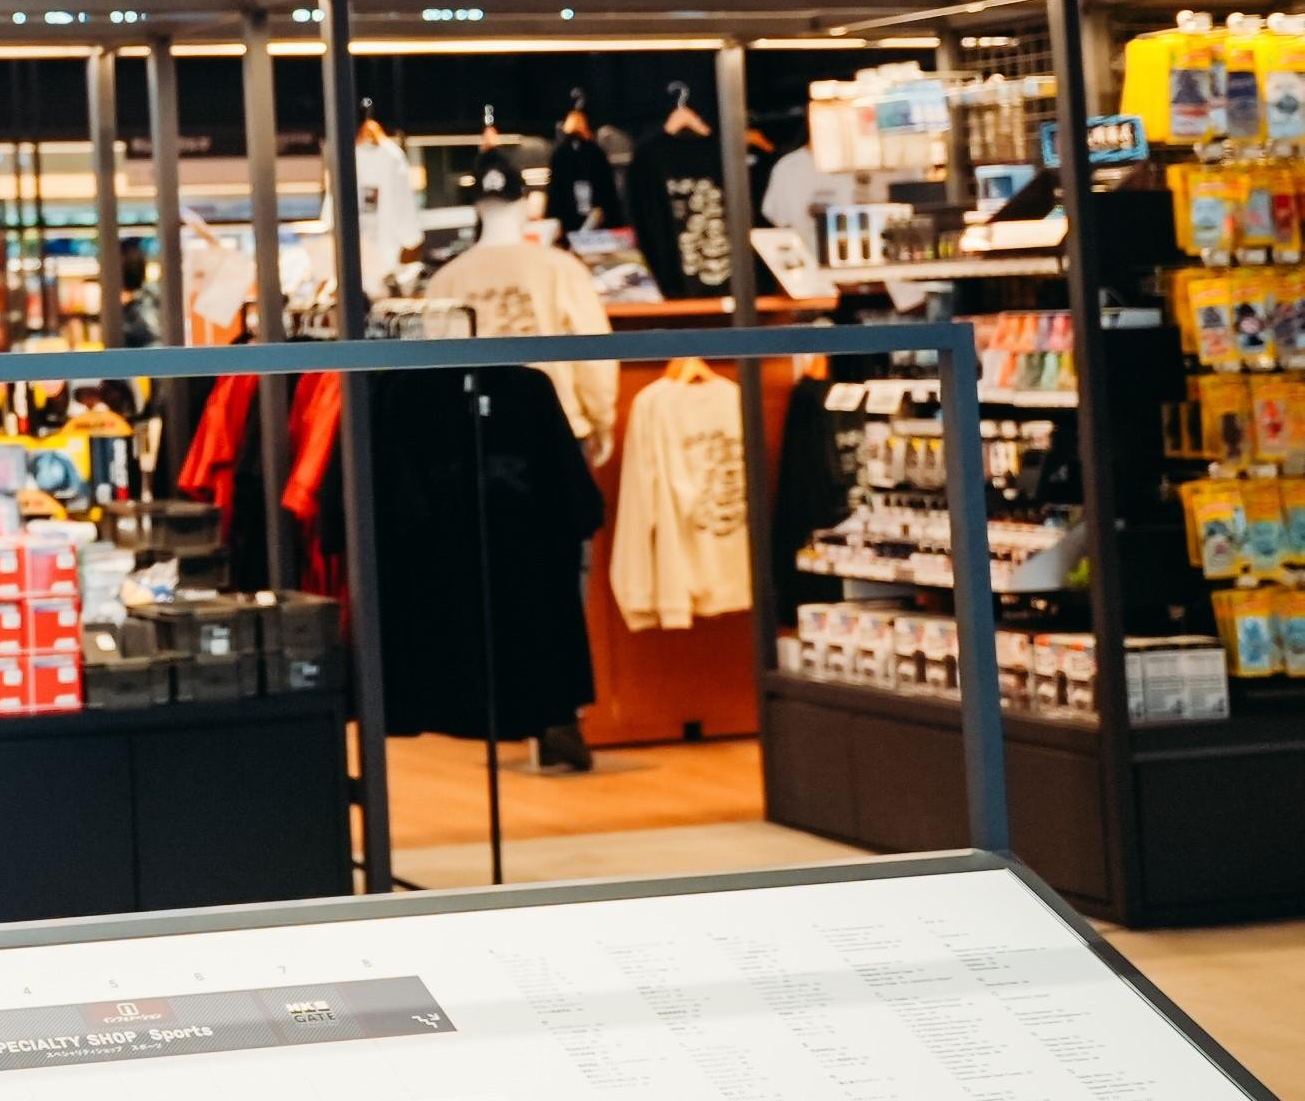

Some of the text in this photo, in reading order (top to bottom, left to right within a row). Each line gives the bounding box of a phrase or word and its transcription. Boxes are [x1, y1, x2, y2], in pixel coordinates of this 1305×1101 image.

[294, 1013, 336, 1023] GATE
[87, 1030, 138, 1047] SHOP
[149, 1024, 214, 1043] Sports
